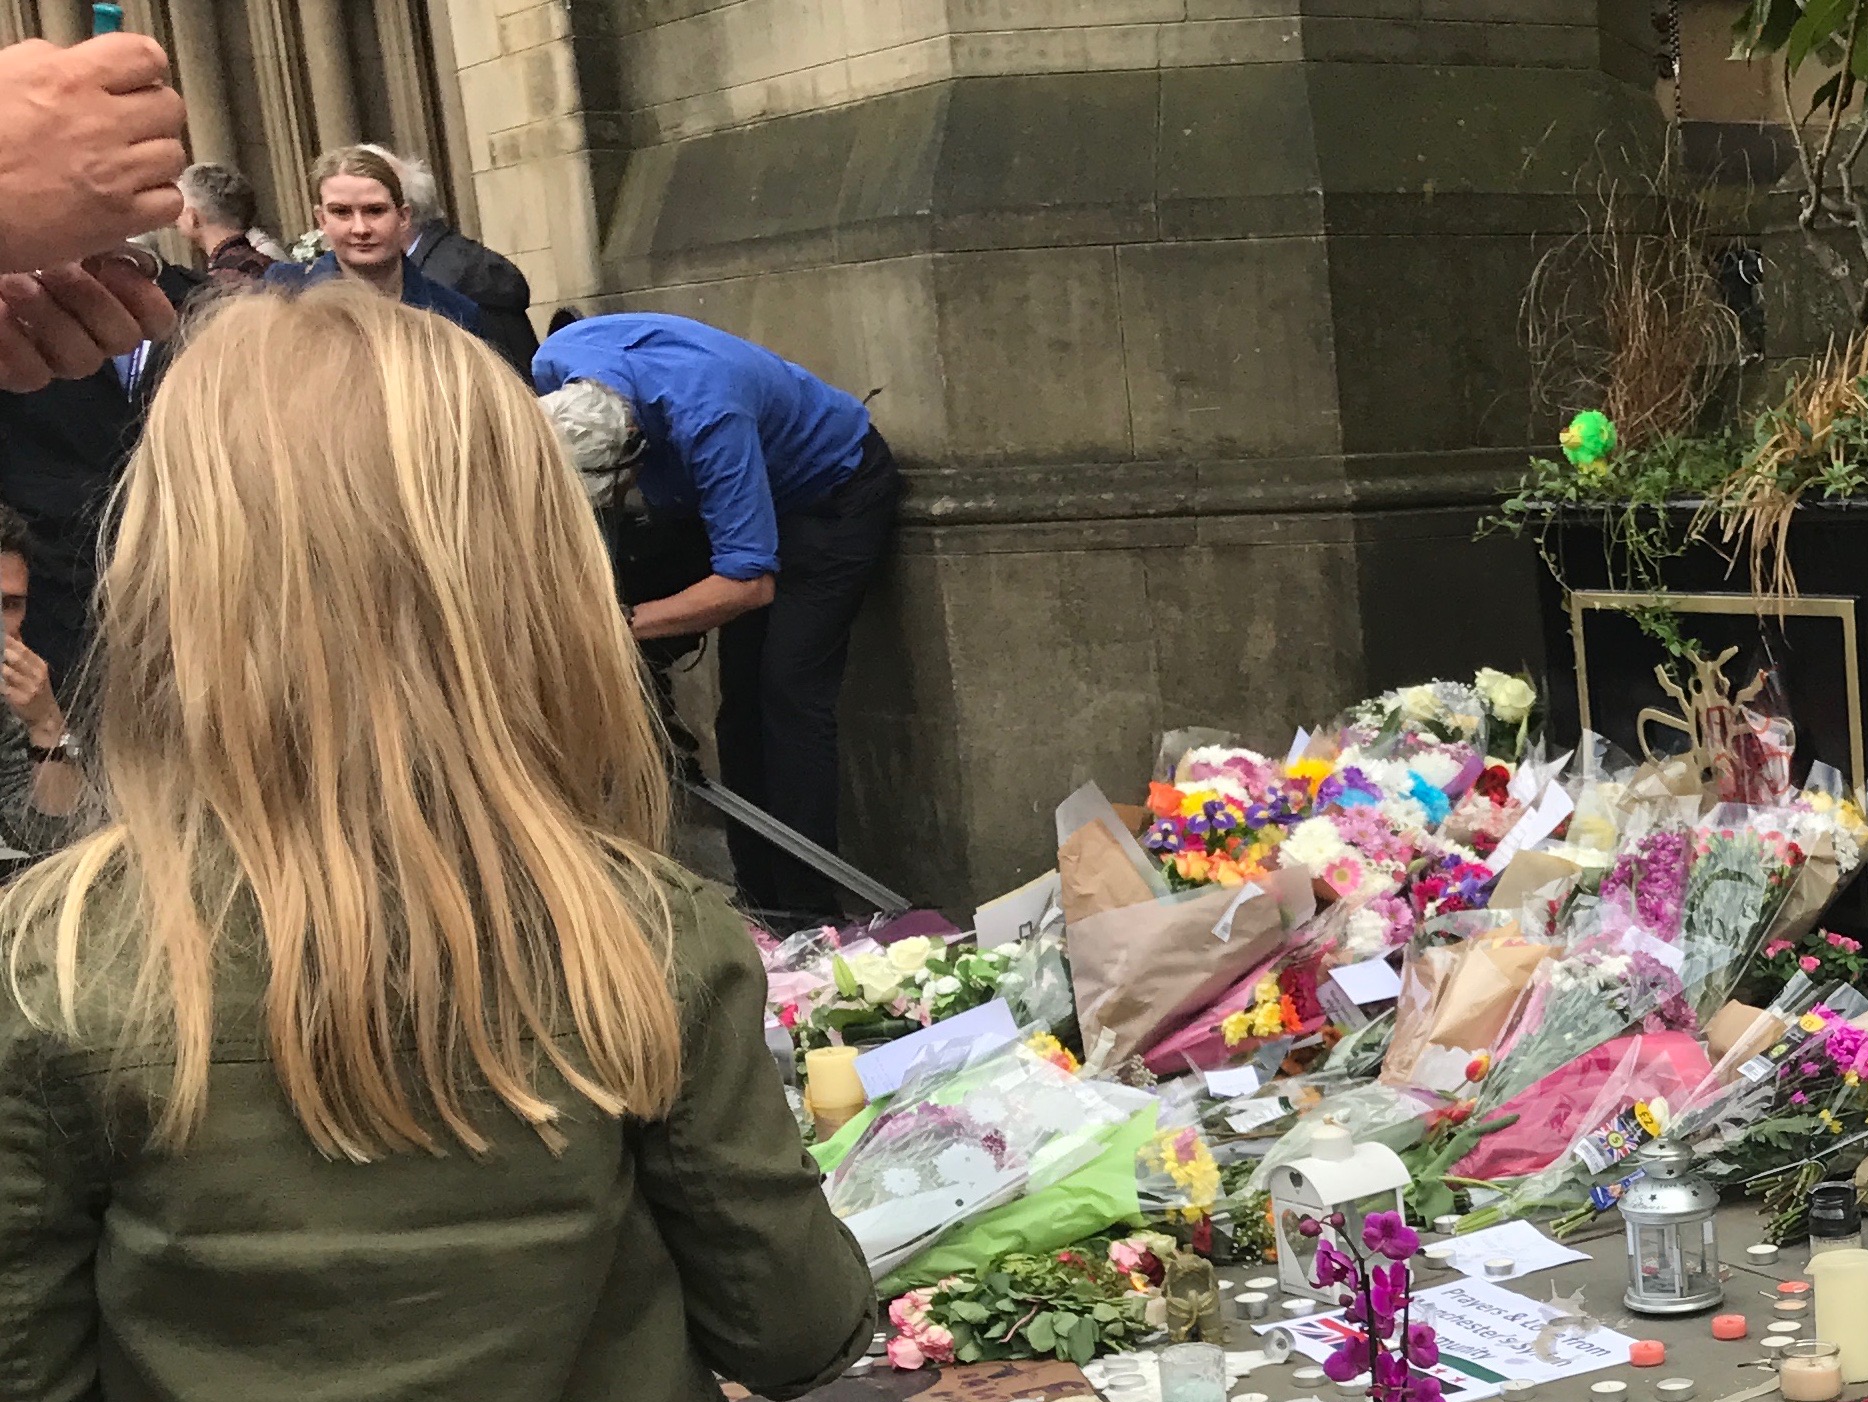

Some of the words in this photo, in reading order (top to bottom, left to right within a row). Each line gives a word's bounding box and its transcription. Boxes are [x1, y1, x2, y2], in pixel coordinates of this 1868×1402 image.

[1441, 1288, 1508, 1316] Prayers
[1503, 1312, 1528, 1323] &
[1519, 1319, 1567, 1341] Loe
[1561, 1333, 1612, 1357] from
